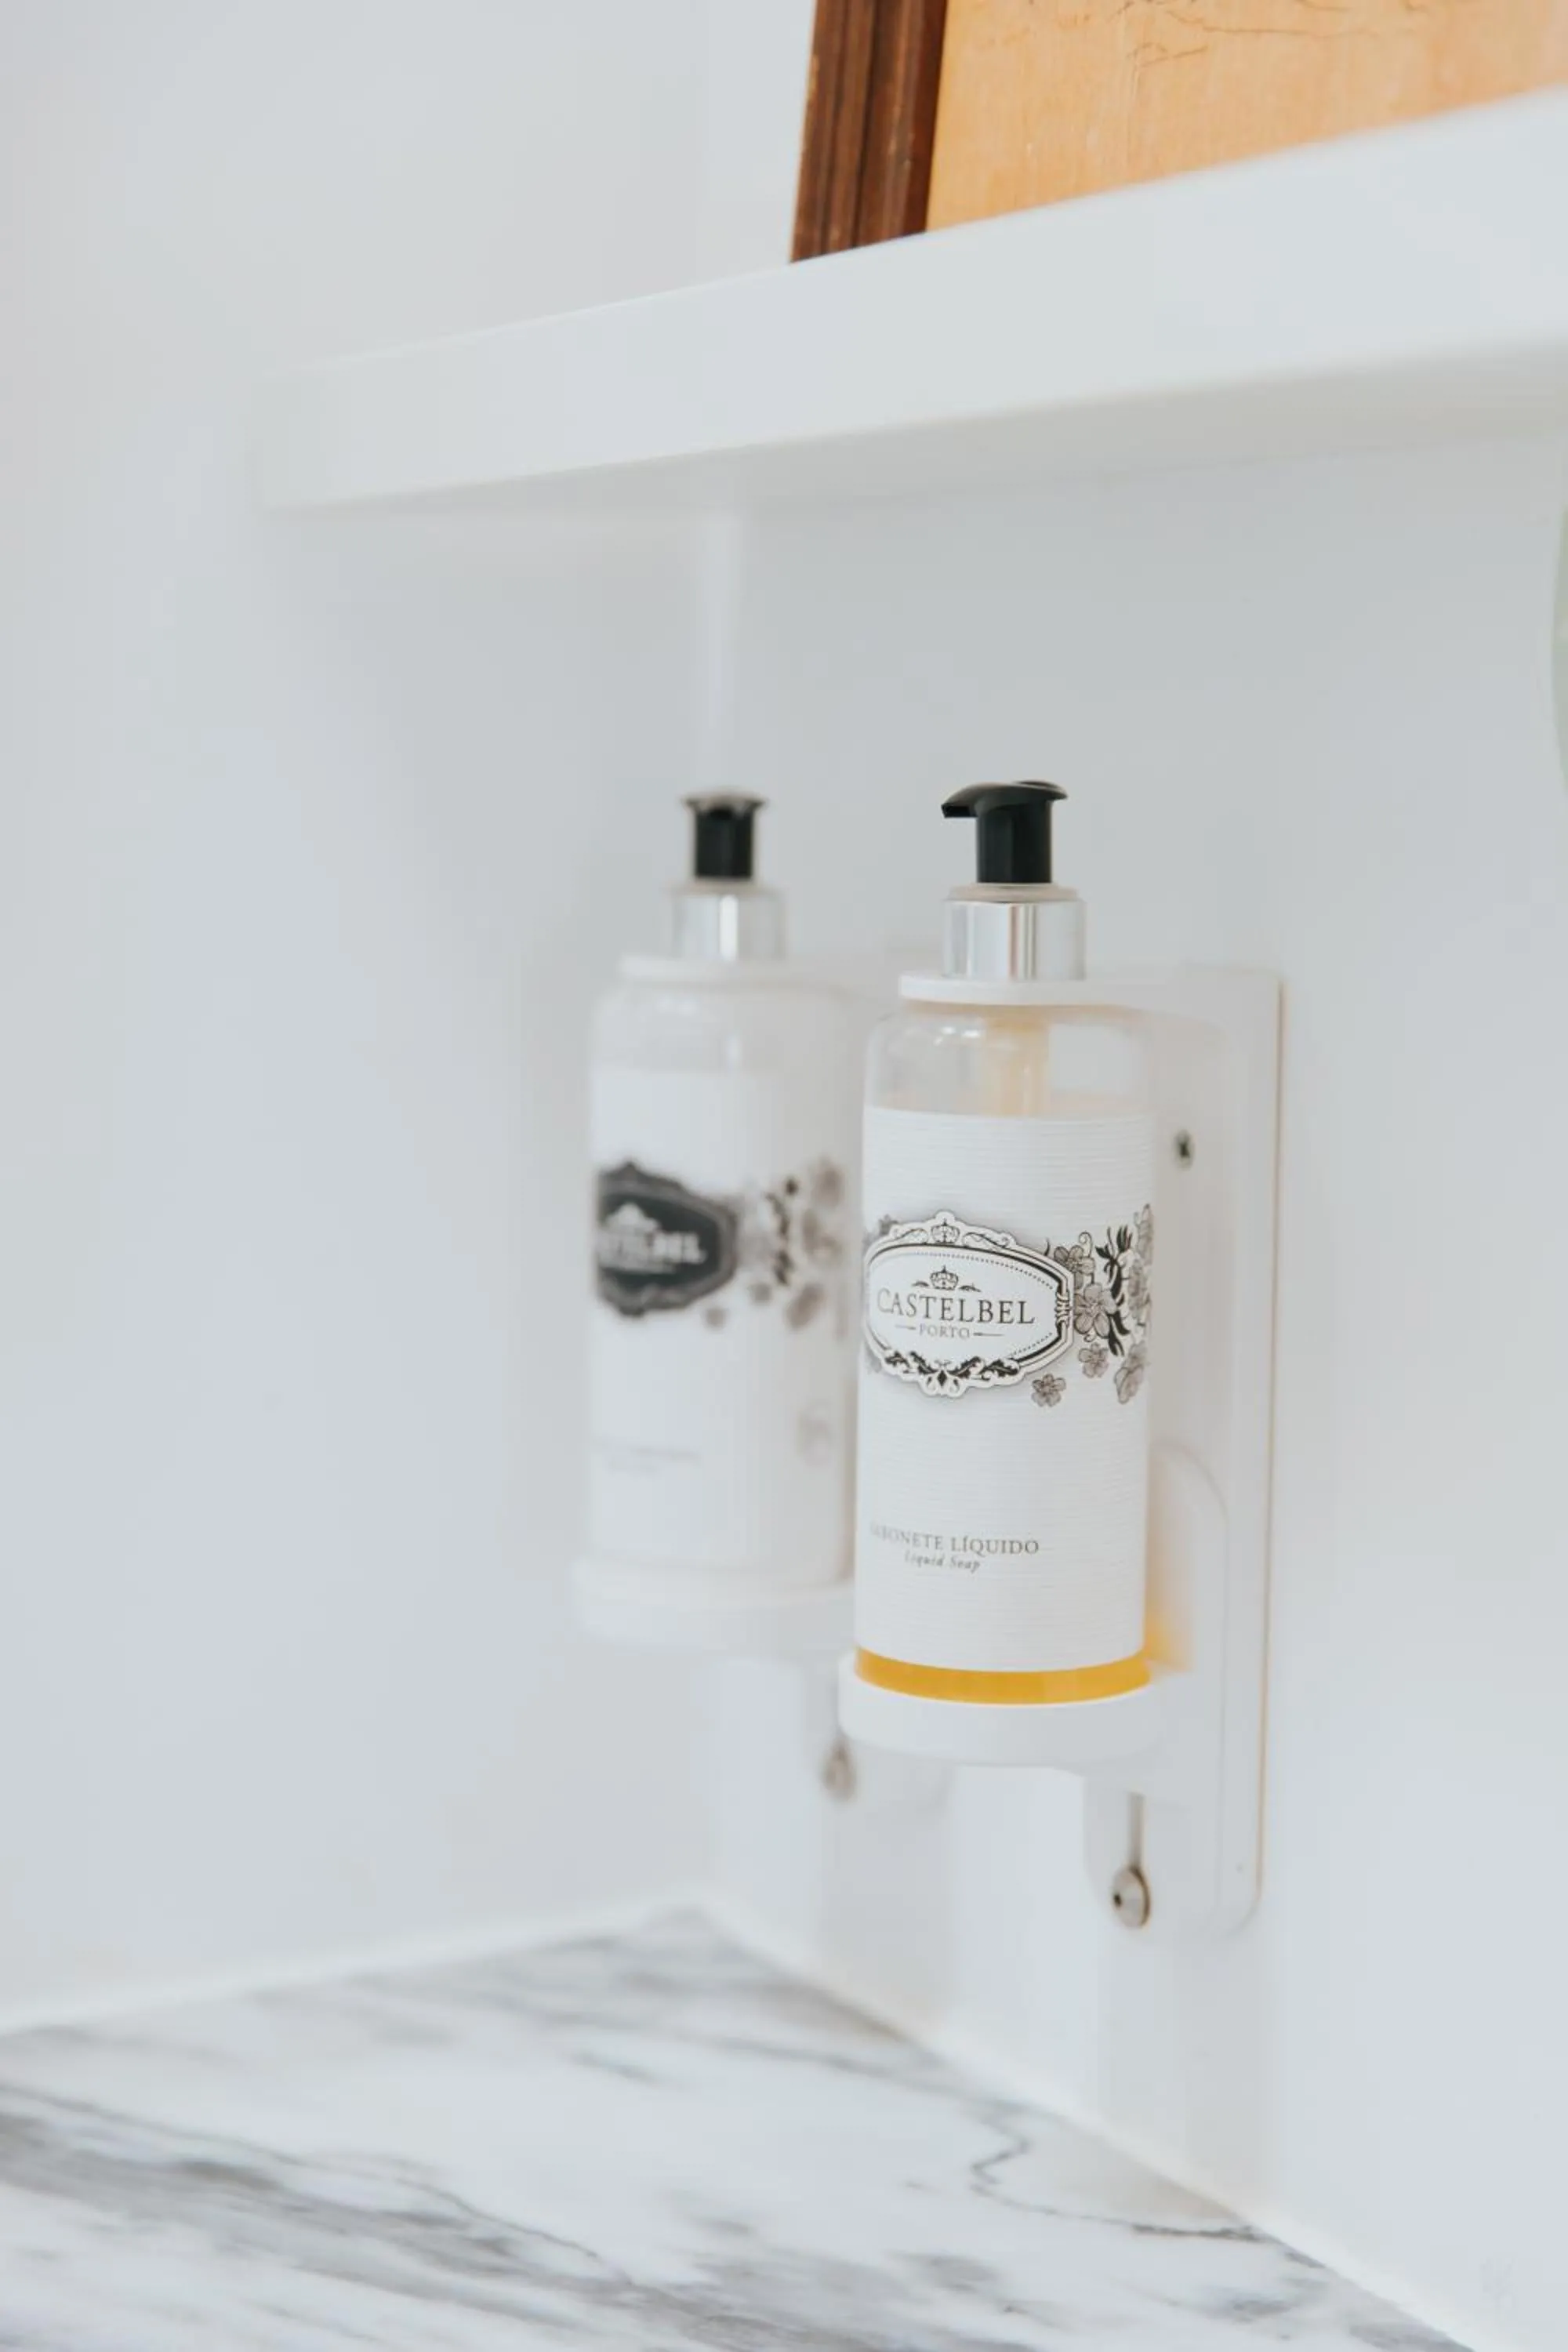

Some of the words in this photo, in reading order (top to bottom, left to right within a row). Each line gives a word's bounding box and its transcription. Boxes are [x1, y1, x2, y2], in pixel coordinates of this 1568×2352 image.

[877, 1287, 1036, 1325] CASTELBEL
[920, 1324, 970, 1339] PORTO
[950, 1535, 1040, 1558] LÍQUIDO
[905, 1550, 946, 1568] Liquid
[950, 1555, 981, 1573] Soap
